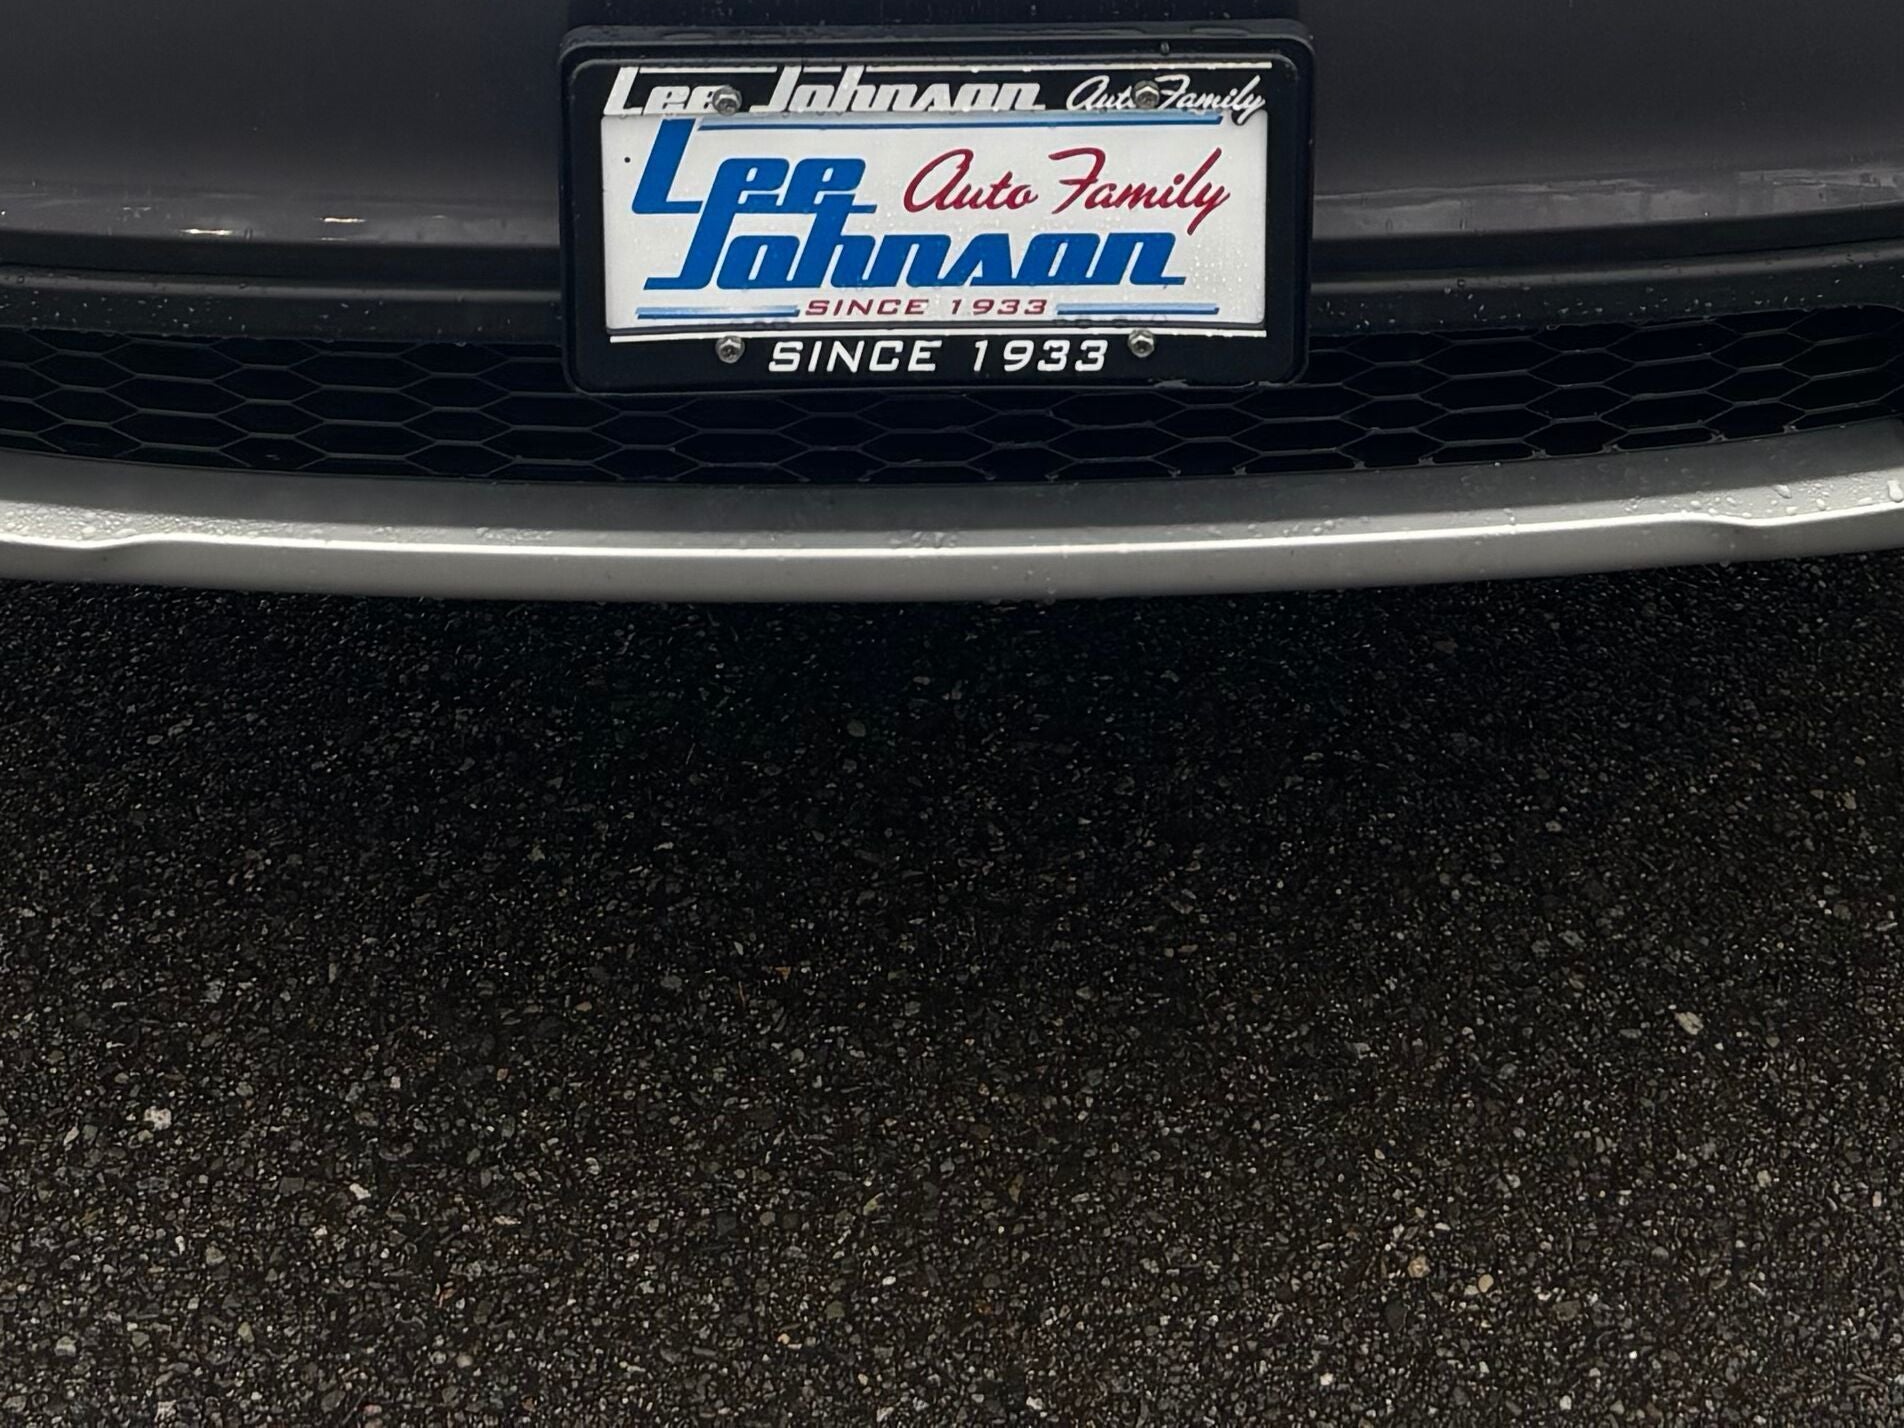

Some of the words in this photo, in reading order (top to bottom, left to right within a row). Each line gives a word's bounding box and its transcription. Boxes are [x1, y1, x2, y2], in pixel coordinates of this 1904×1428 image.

[749, 65, 1046, 114] Johnson
[1065, 75, 1154, 111] Aut
[1152, 74, 1267, 125] Family
[631, 118, 877, 214] Lee
[903, 148, 1039, 213] Auto
[1048, 147, 1231, 236] Family
[643, 204, 1187, 291] Johnson
[805, 299, 930, 316] SINCE
[952, 299, 1048, 315] 1933
[768, 340, 943, 373] SINCE
[973, 339, 1109, 372] 1933
